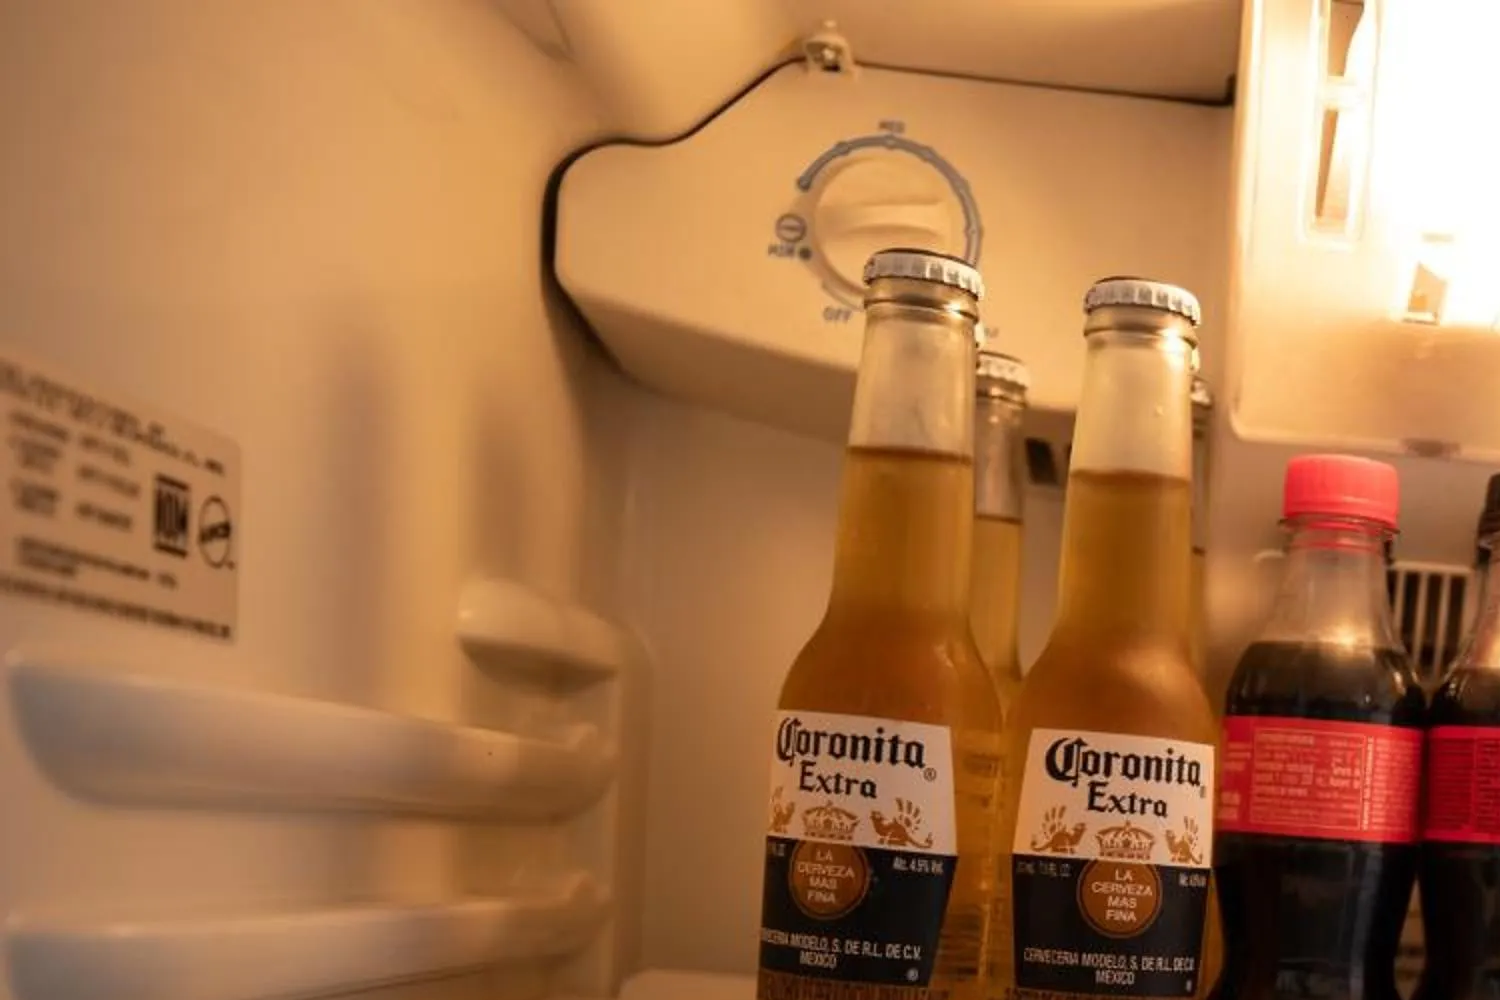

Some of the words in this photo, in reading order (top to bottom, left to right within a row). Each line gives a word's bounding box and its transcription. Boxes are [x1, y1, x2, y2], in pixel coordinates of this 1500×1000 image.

[776, 715, 926, 769] Coronita
[1045, 735, 1201, 787] Coronita
[798, 759, 877, 799] Extra
[1087, 780, 1167, 818] Extra
[816, 850, 834, 862] LA
[797, 861, 855, 879] CERVEZA
[1114, 868, 1133, 881] LA
[806, 890, 836, 903] FINA
[1091, 881, 1153, 896] CERVEZA
[1105, 909, 1137, 922] FINA
